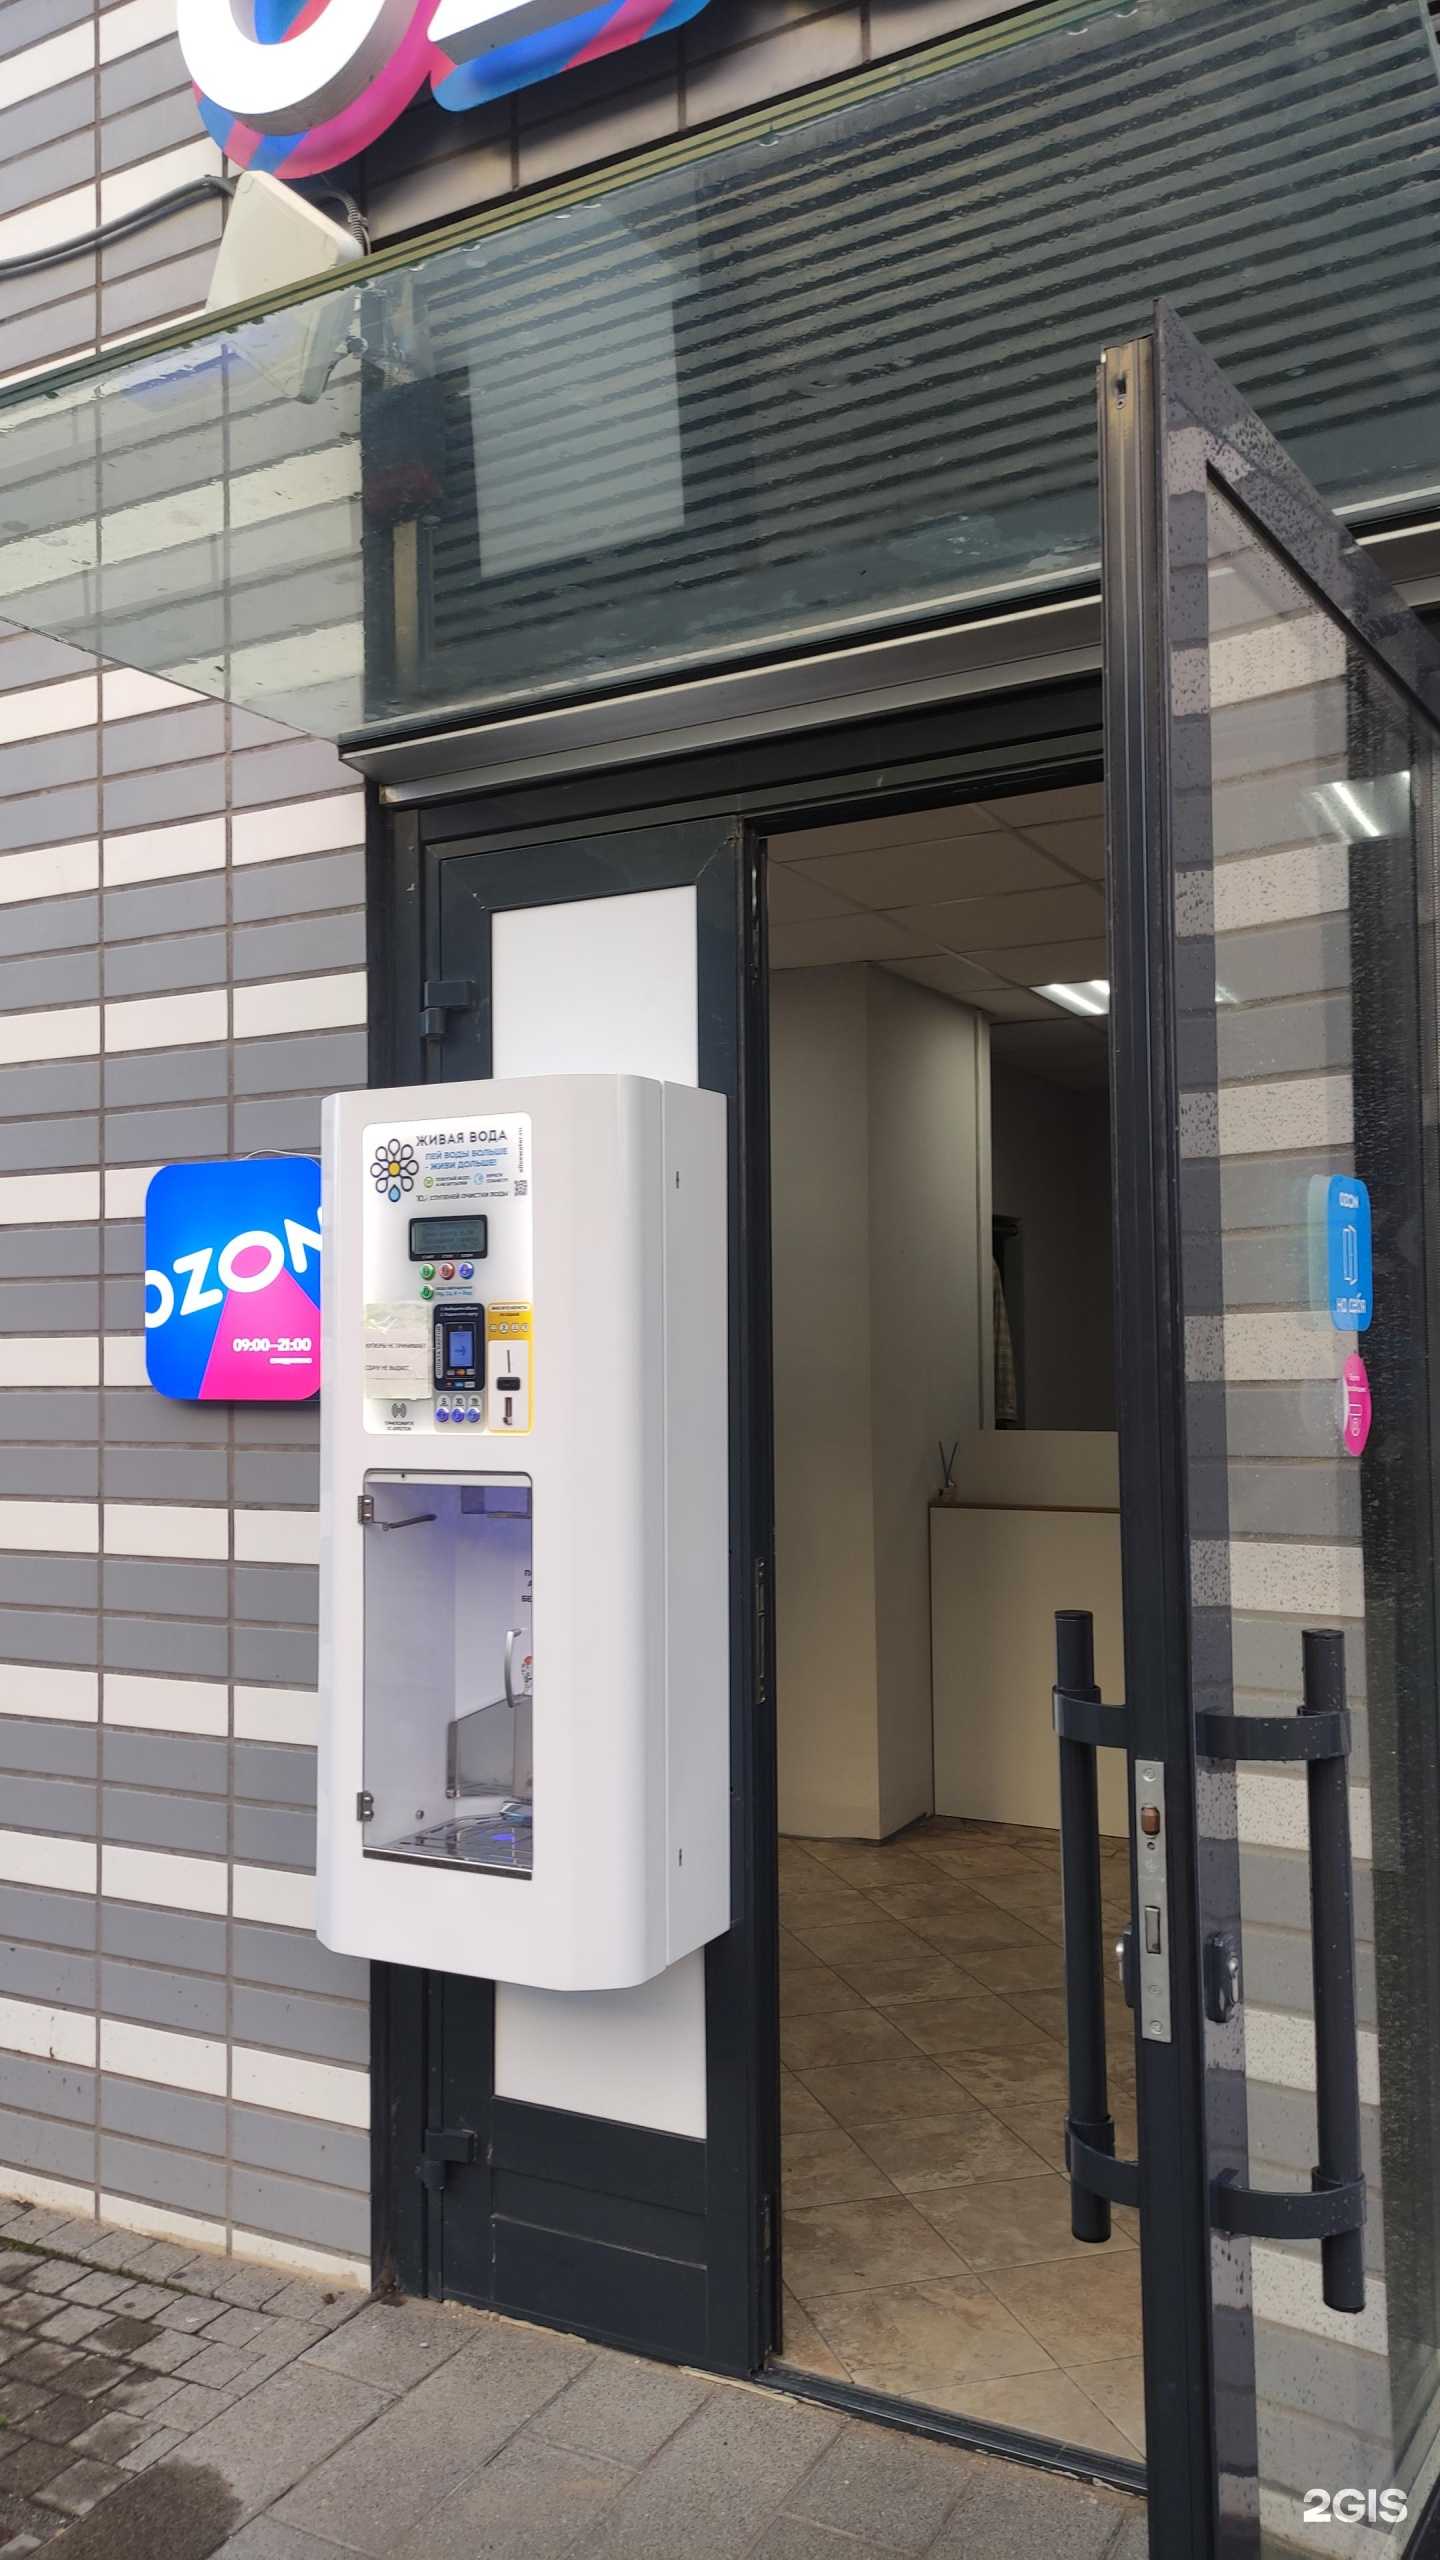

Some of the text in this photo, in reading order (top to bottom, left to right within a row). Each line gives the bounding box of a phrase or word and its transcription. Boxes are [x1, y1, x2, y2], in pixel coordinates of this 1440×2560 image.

[416, 1130, 507, 1146] ЖИВАЯ ВОДА
[444, 1151, 470, 1159] ВОДЫ
